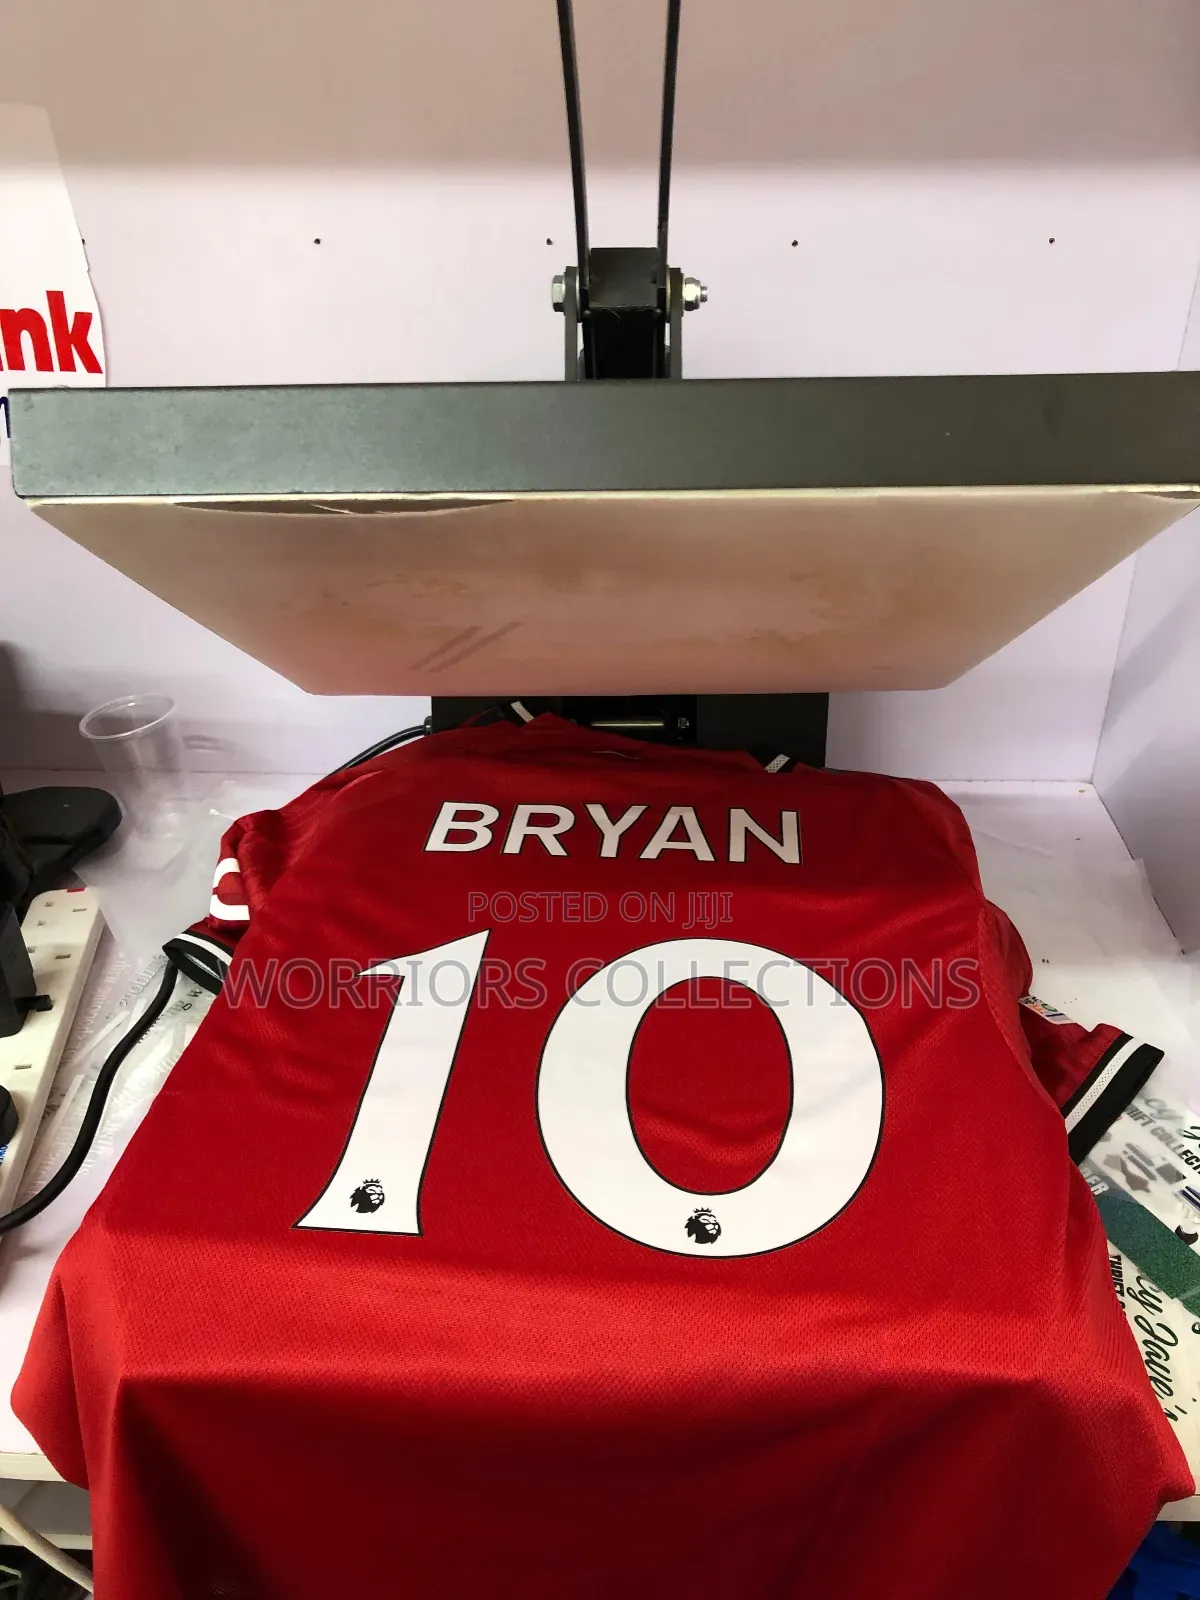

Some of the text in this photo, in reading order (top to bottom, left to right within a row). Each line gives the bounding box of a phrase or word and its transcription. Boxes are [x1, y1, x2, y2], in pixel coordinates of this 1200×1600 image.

[0, 290, 104, 374] nk
[423, 800, 803, 865] BRYAN
[290, 927, 887, 1260] 10
